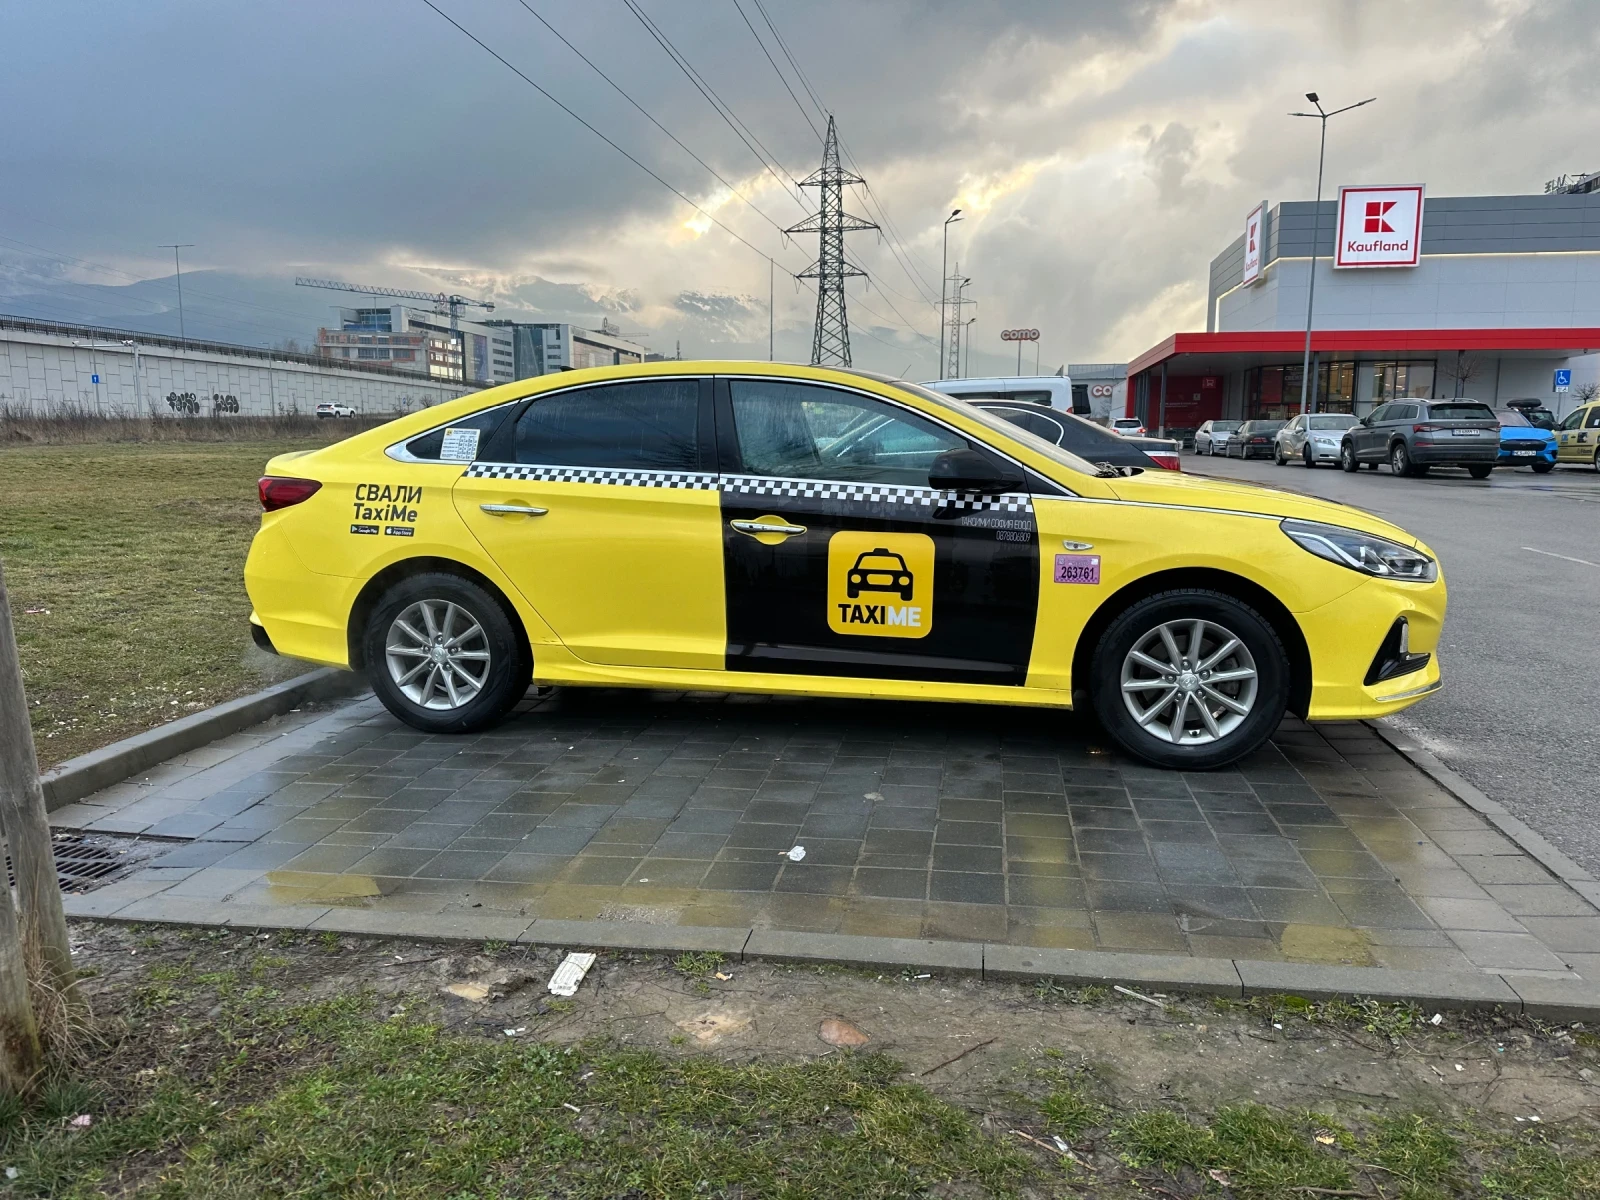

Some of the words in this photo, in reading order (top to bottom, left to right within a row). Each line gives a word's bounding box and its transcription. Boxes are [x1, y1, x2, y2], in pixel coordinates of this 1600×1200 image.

[1347, 240, 1409, 252] Kaufland
[355, 483, 423, 504] СВАЛИ
[353, 502, 418, 522] TaxiMe
[990, 518, 1014, 529] СОФИЯ
[1014, 520, 1032, 532] ЕООД
[1061, 566, 1095, 579] 263761
[838, 603, 922, 627] TAXIME
